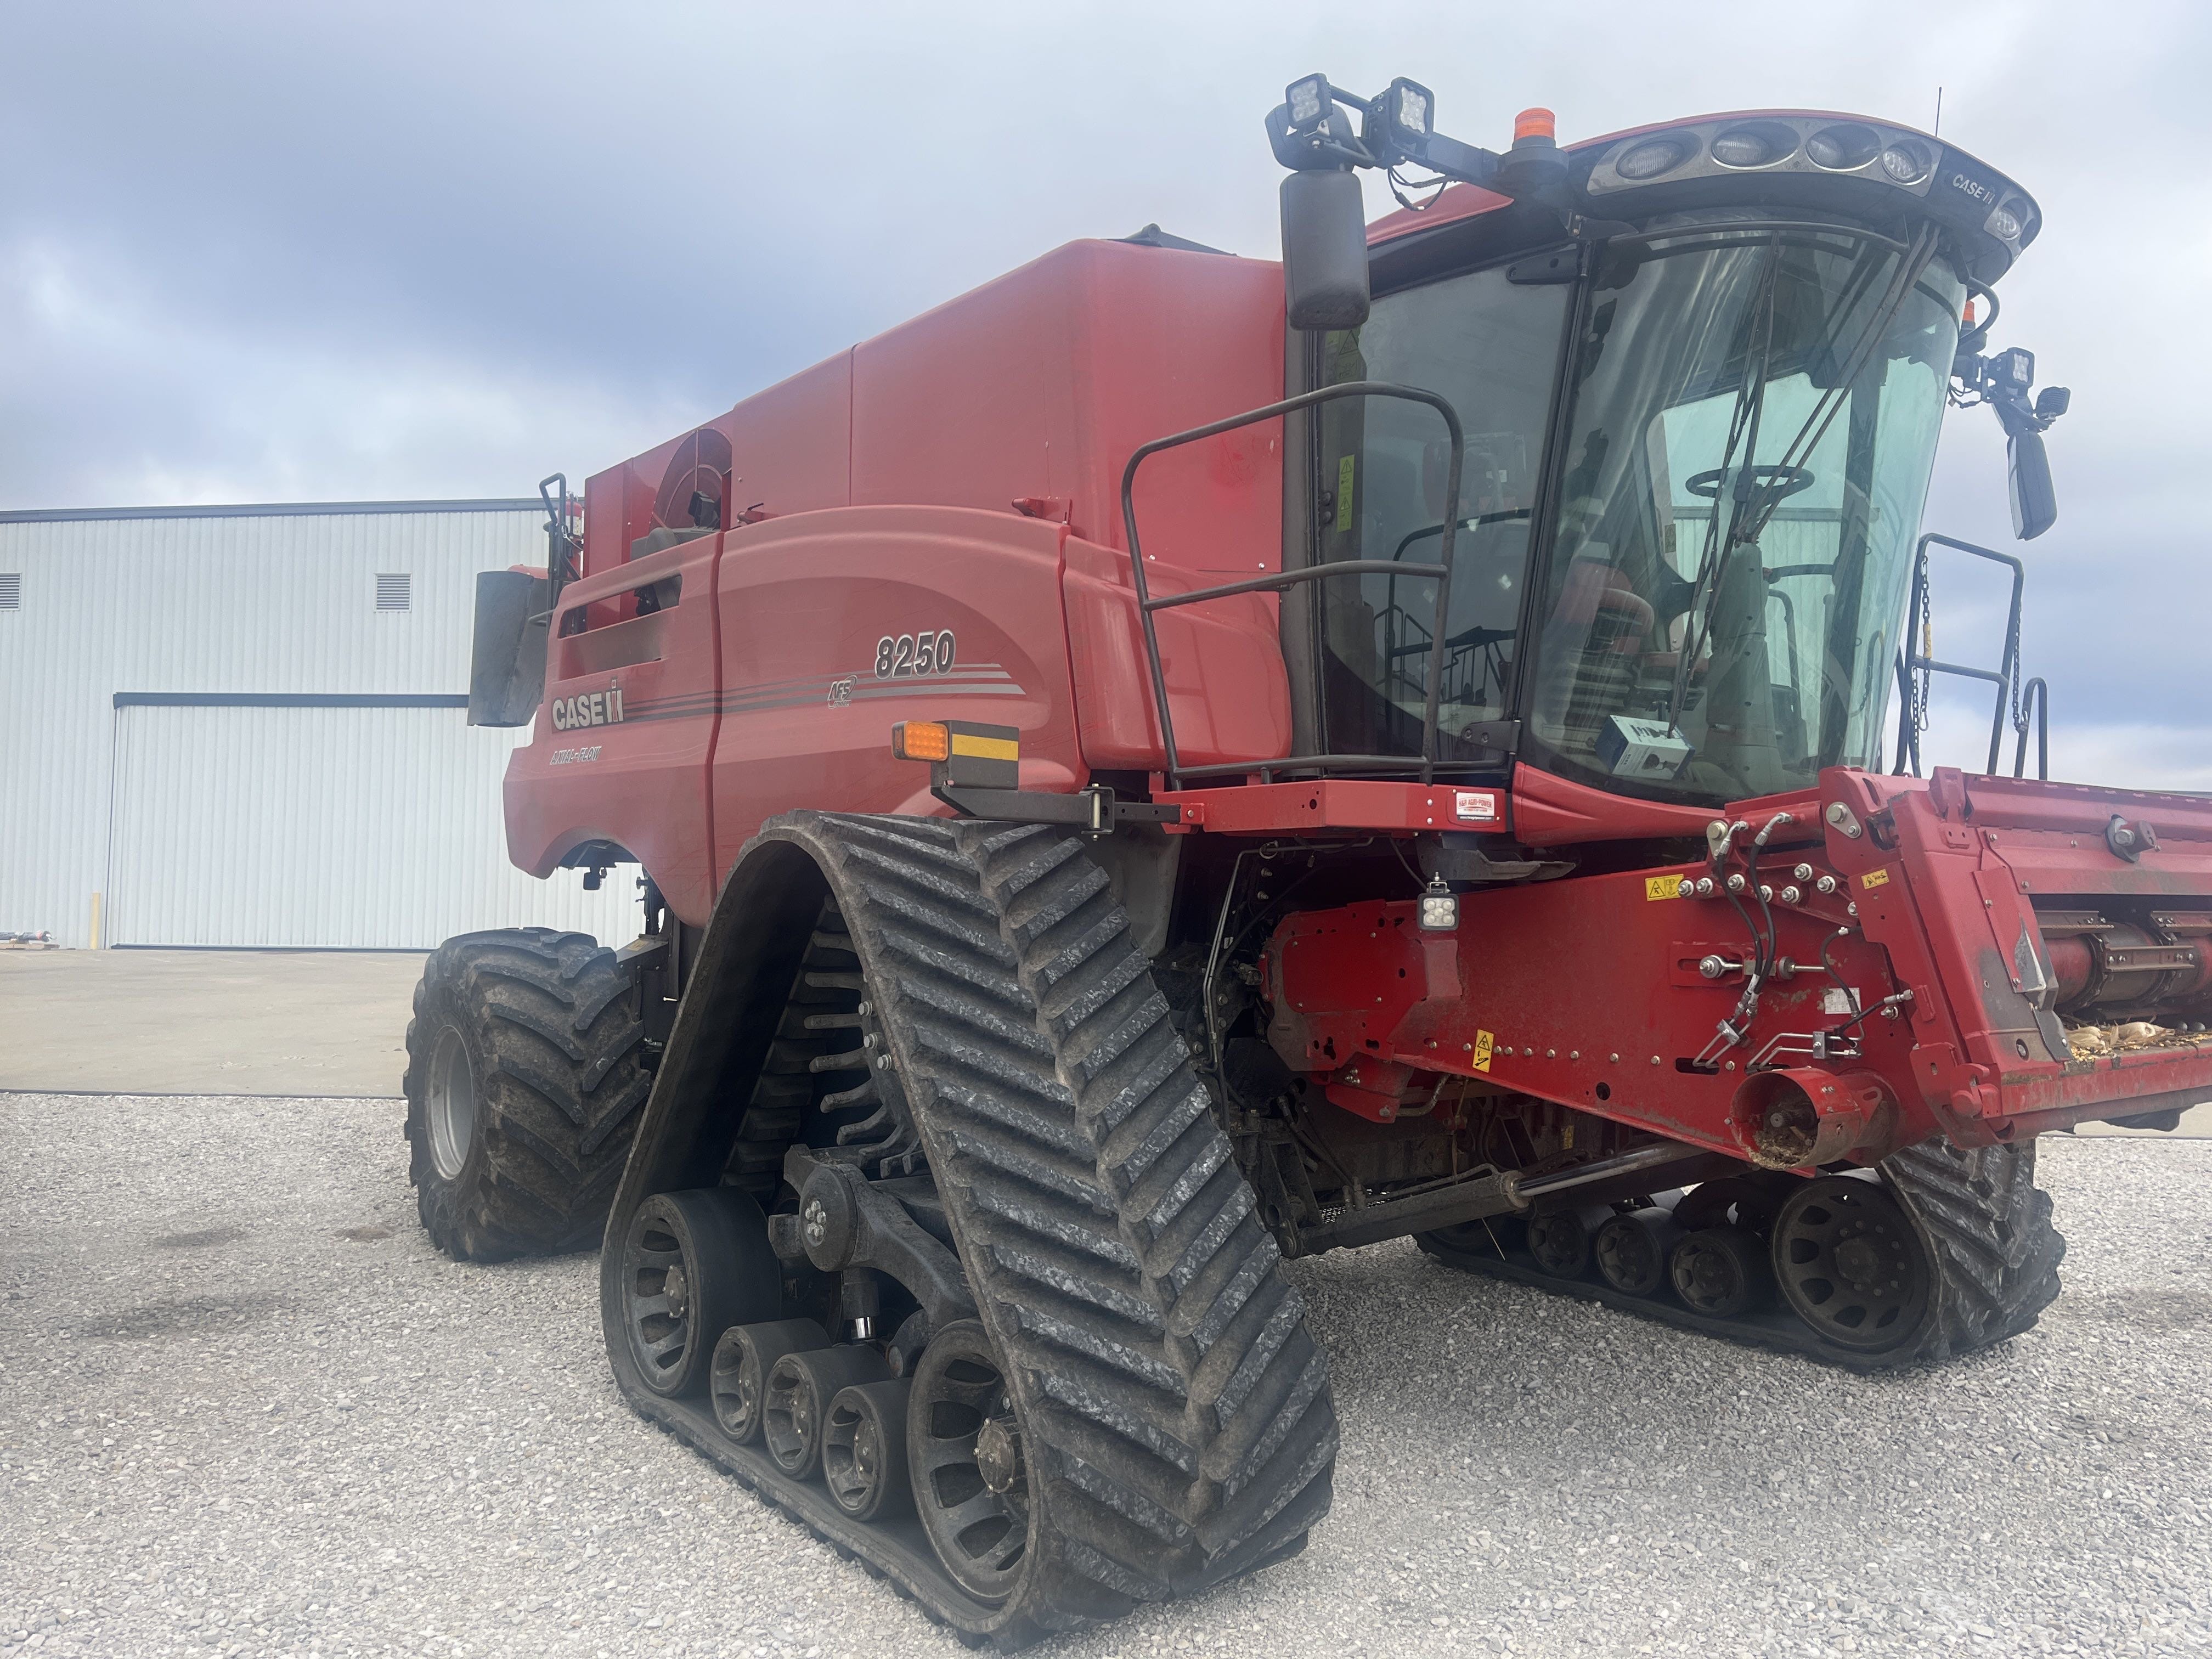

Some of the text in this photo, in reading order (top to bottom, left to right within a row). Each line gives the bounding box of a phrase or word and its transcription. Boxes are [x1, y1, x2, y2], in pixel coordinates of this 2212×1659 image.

[1953, 174, 1985, 199] CASE
[874, 629, 956, 680] 8250
[827, 680, 852, 701] AFS
[552, 692, 604, 730] CASE
[550, 746, 602, 765] AXIAL-FLOW
